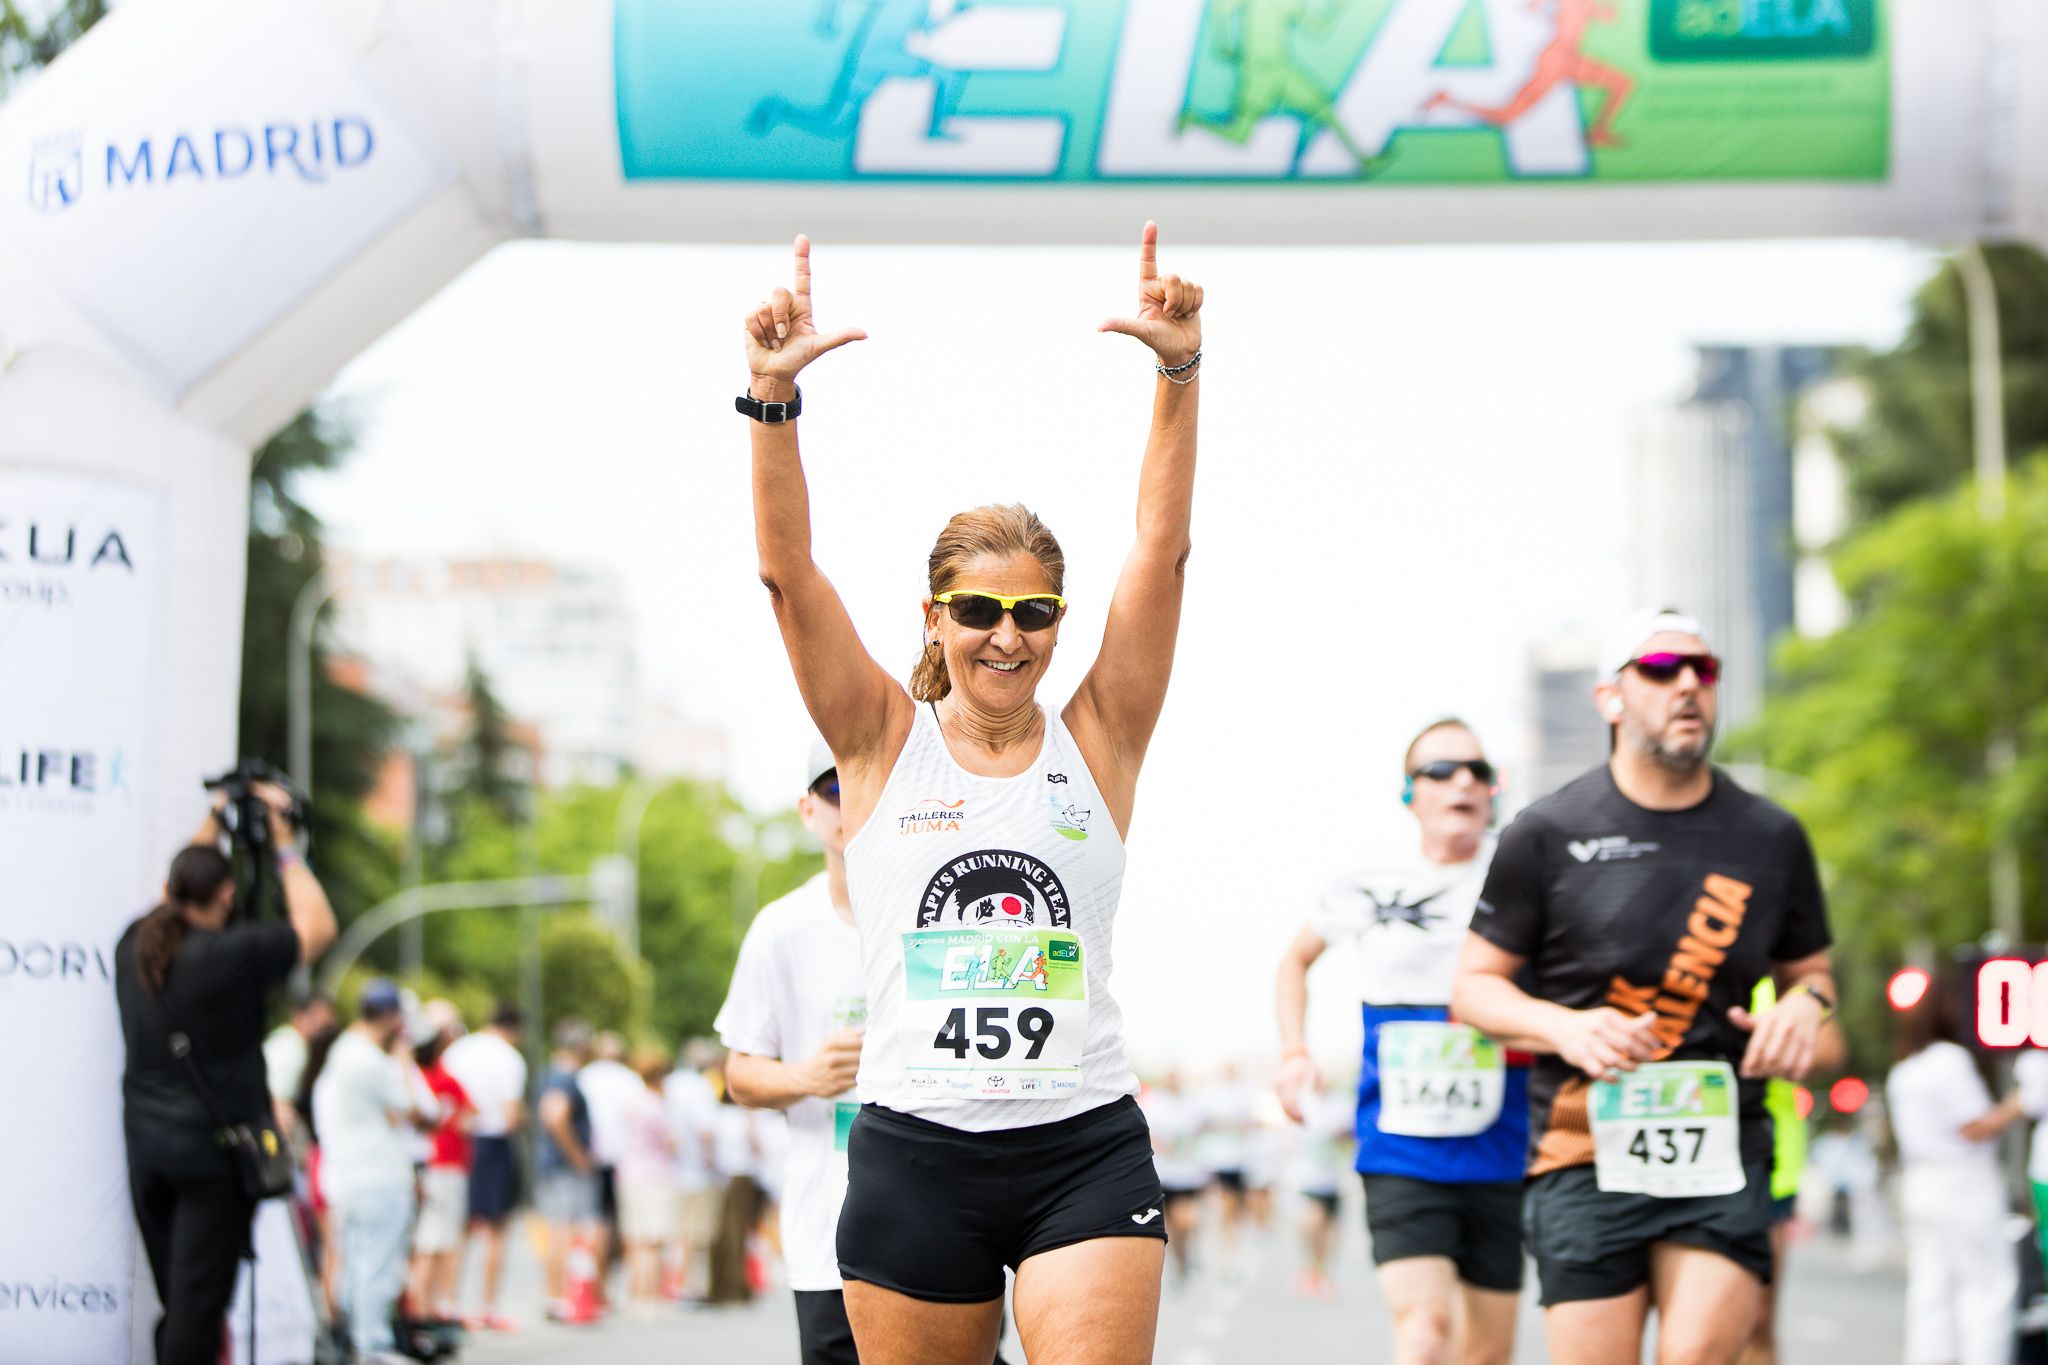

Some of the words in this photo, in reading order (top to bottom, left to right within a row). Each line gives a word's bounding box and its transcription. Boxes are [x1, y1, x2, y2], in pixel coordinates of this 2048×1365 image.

[104, 114, 377, 188] MADRID
[0, 522, 134, 571] UA
[899, 811, 964, 828] TALLERES
[900, 820, 960, 835] JUMA
[922, 871, 955, 928] API'S
[951, 854, 1048, 883] RUNNING
[947, 935, 993, 945] MADRID
[996, 934, 1022, 943] CON
[1024, 935, 1039, 944] LA
[940, 944, 1048, 991] ELA
[934, 1006, 1055, 1060] 459
[1399, 1079, 1481, 1108] 1661
[1621, 1078, 1705, 1115] ELA
[1628, 1127, 1708, 1164] 437
